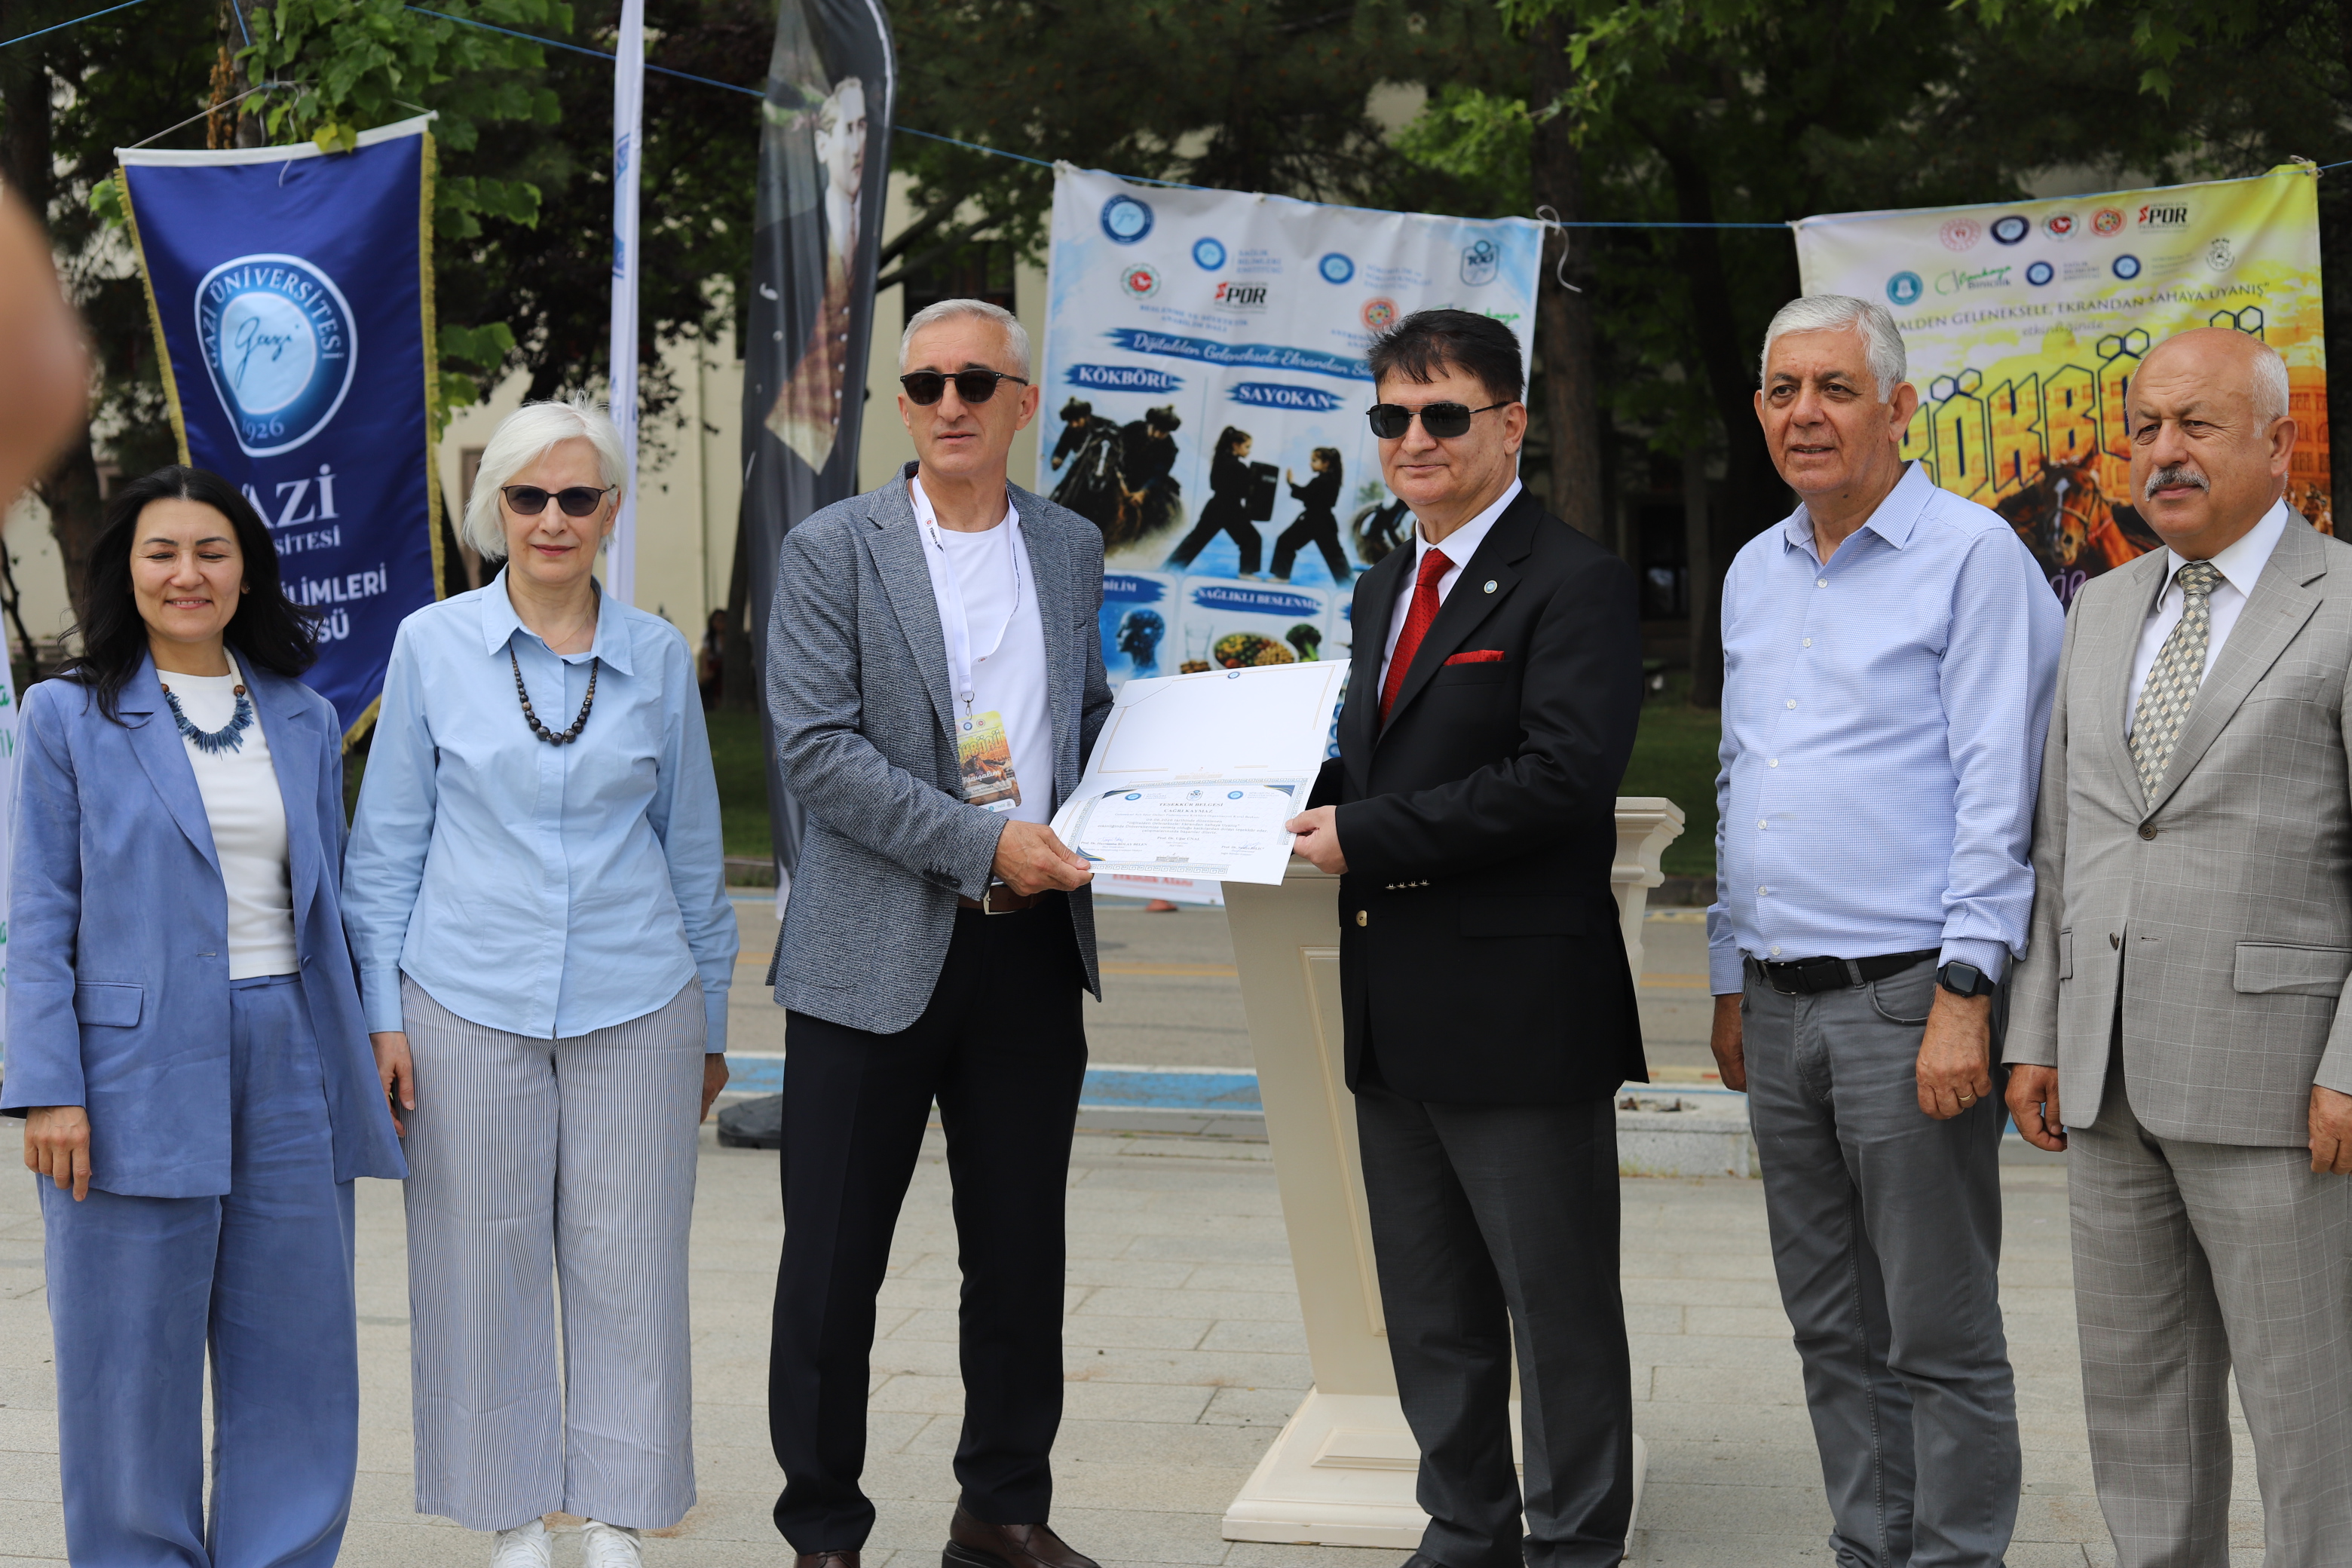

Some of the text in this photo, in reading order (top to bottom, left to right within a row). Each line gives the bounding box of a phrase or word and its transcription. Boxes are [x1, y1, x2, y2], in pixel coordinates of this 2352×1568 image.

[2138, 204, 2188, 225] SPOR
[1214, 281, 1267, 304] SPOR
[2058, 295, 2144, 314] EKRANDAN
[2150, 289, 2204, 305] SAHAYA
[209, 266, 345, 360] ÜNİVERSİTESİ
[1133, 332, 1200, 357] Dijitalden
[1079, 366, 1173, 389] KÖKBÖRÜ
[1239, 385, 1331, 409] SAYOKAN
[242, 415, 285, 443] 1926
[242, 463, 340, 529] AZİ
[274, 525, 341, 557] SİTESİ
[281, 562, 387, 607] İLİMLERİ
[1103, 576, 1137, 593] BİLİM
